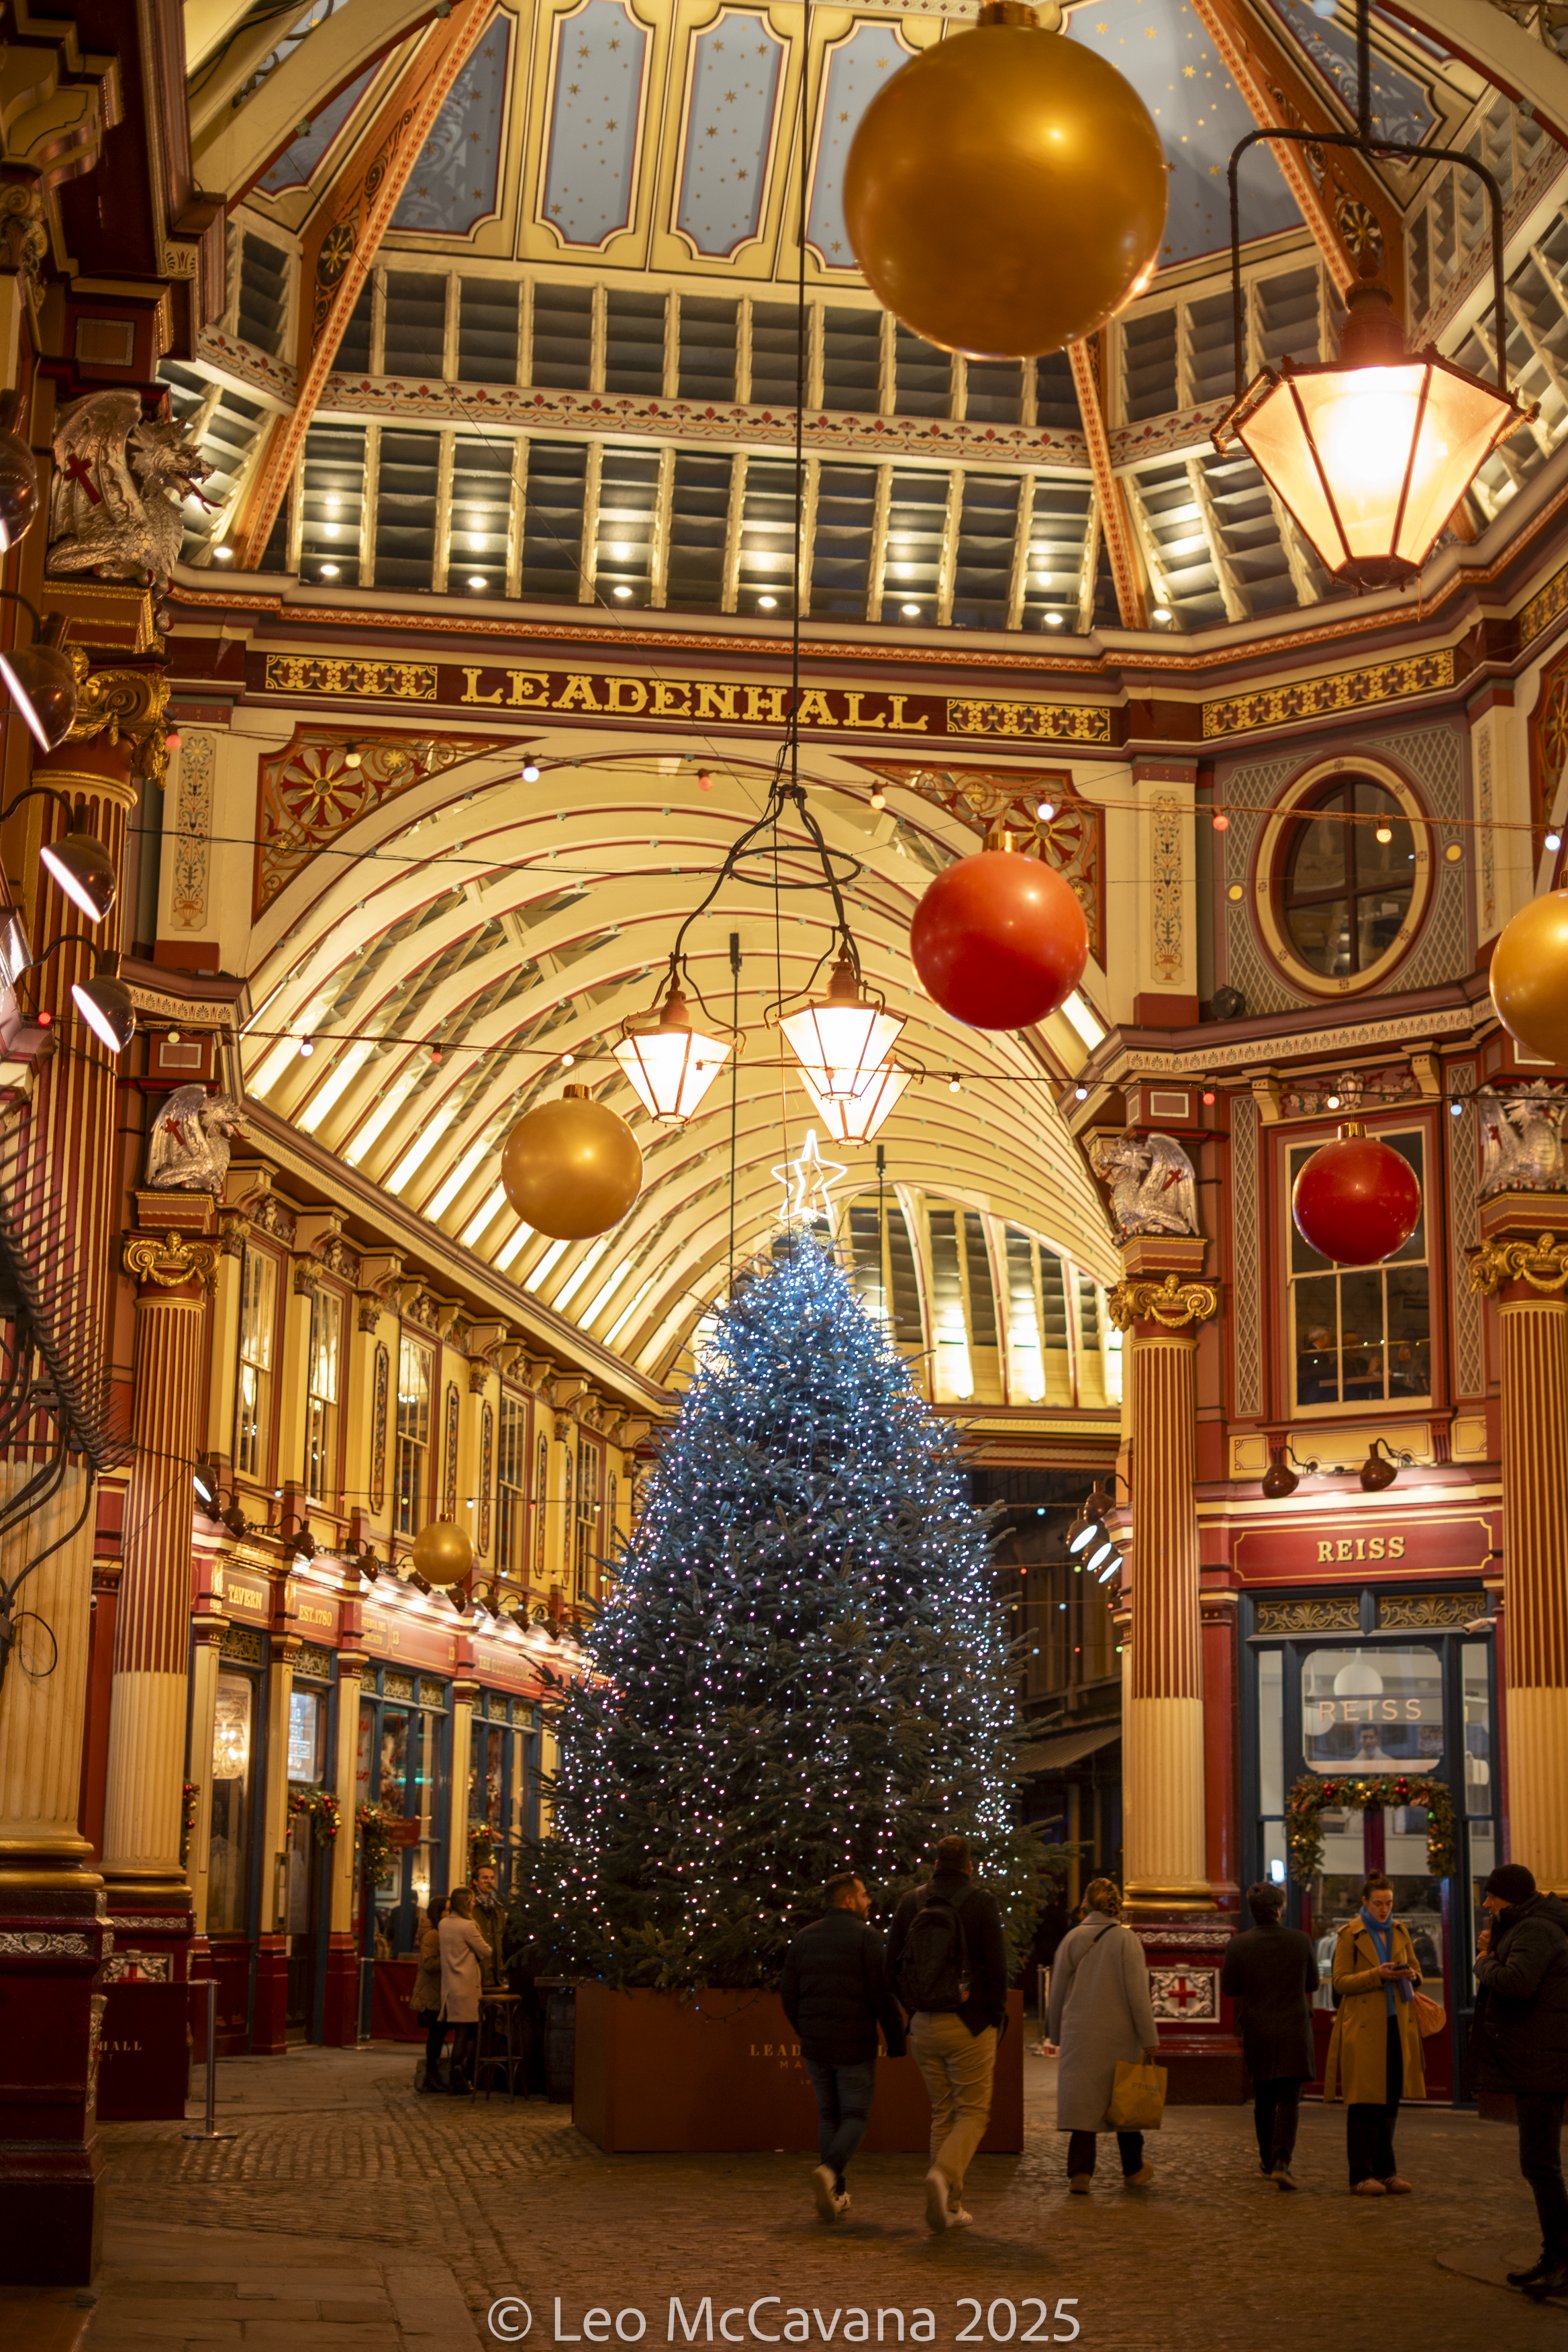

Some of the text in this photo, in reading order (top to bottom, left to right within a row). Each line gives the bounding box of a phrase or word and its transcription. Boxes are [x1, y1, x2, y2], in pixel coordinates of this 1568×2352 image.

[460, 667, 928, 732] LEADENHALL
[1317, 1536, 1405, 1563] REISS
[228, 1583, 262, 1610] TAVERN
[299, 1604, 332, 1627] EST.1780
[479, 1655, 491, 1671] THE
[1319, 1699, 1422, 1722] REISS
